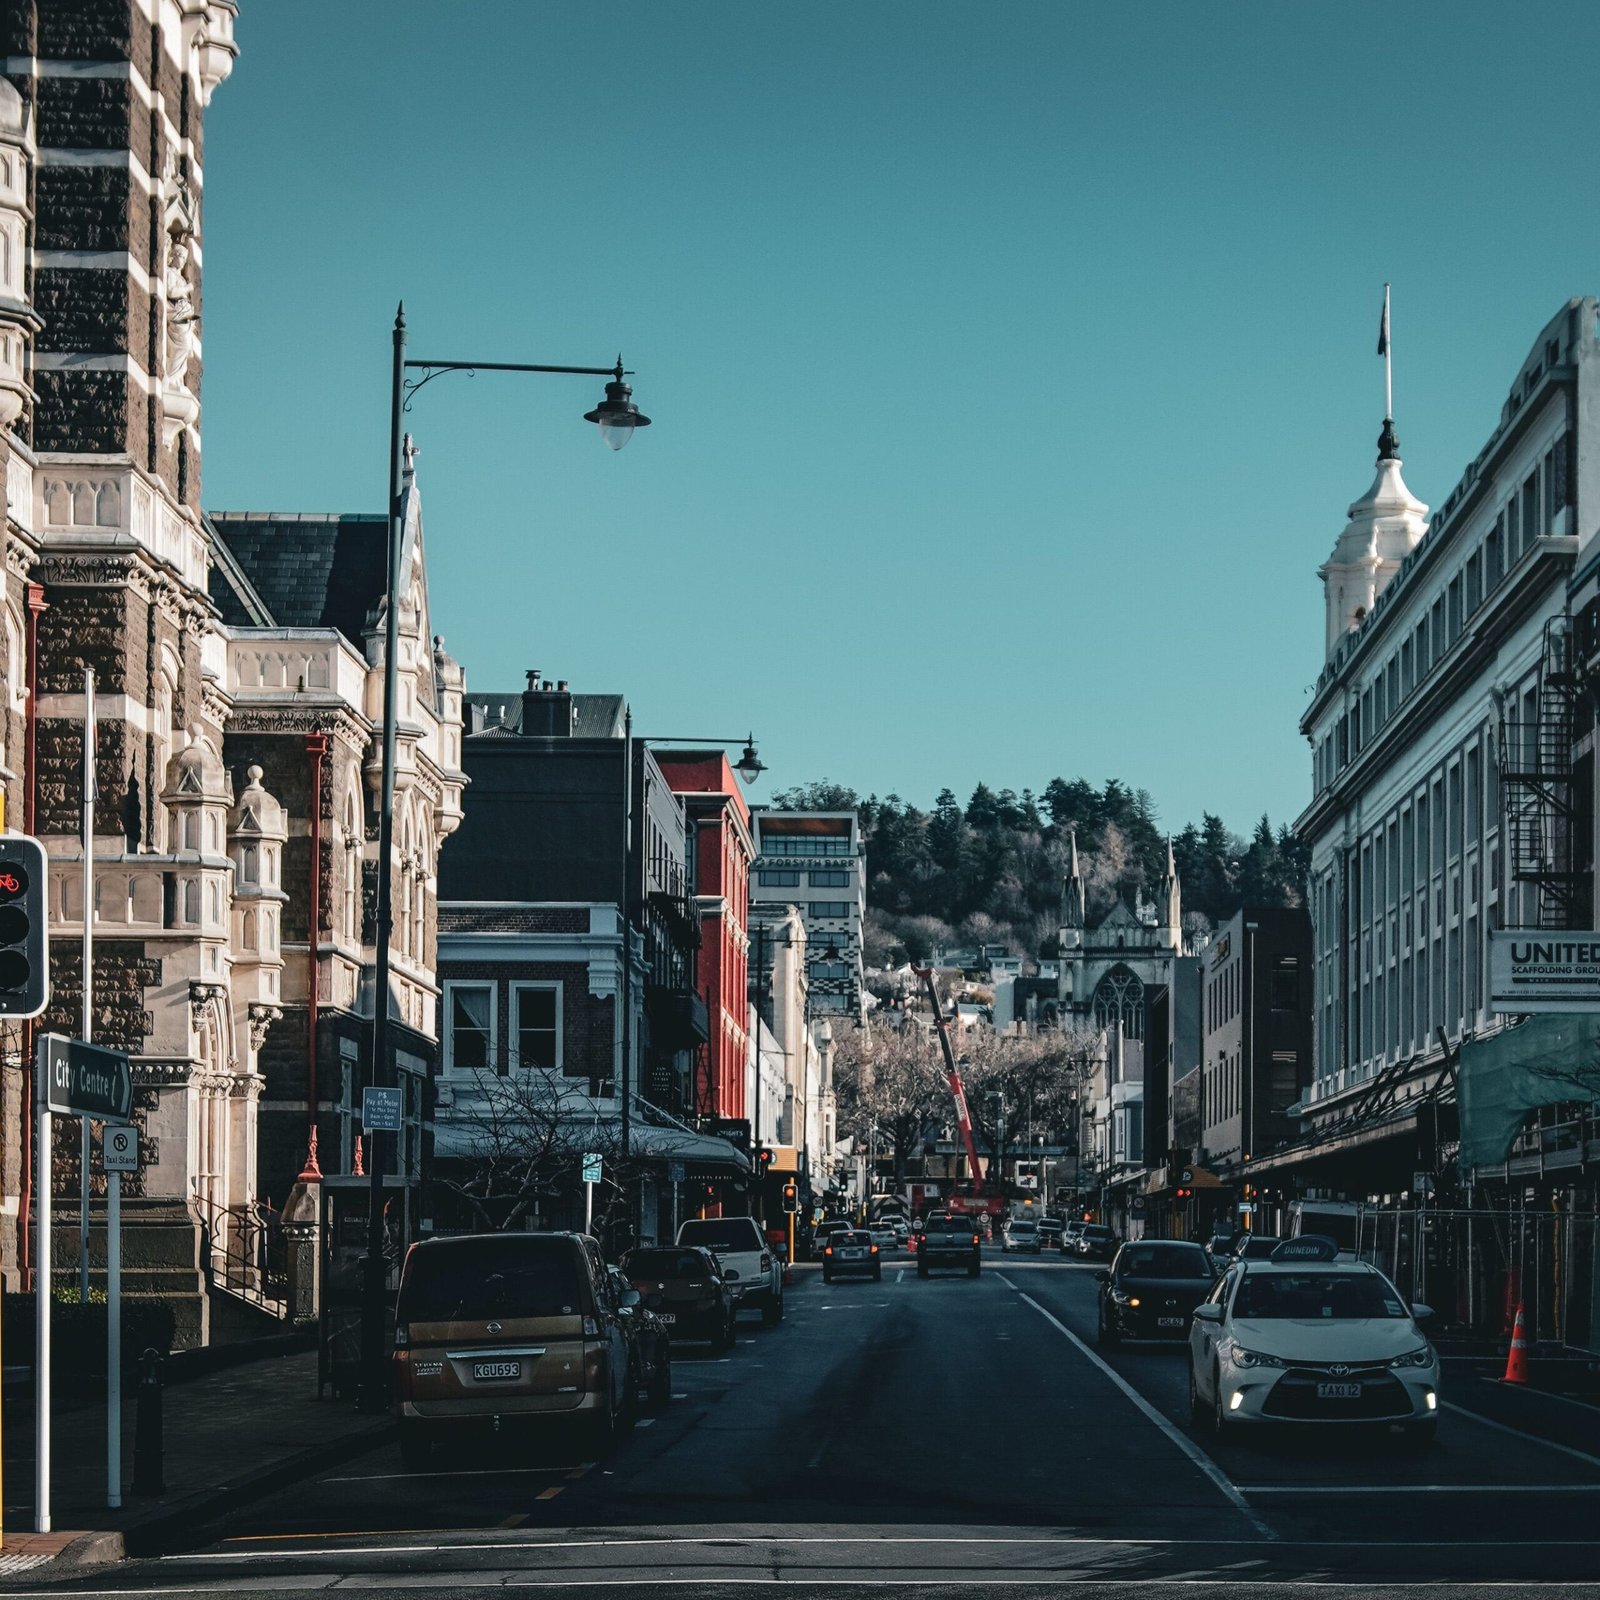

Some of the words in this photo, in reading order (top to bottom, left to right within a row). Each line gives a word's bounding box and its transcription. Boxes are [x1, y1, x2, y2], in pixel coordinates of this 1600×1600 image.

[768, 858, 821, 867] FORSYTH
[824, 859, 855, 867] BARR
[1511, 966, 1572, 974] SCAFFOLDING
[1575, 966, 1600, 974] GROU
[56, 1058, 75, 1095] City
[80, 1065, 109, 1096] Centre
[105, 1156, 118, 1164] Taxi
[119, 1156, 137, 1164] Stand
[1284, 1246, 1320, 1255] DUNEDIN
[475, 1363, 519, 1378] KGU693
